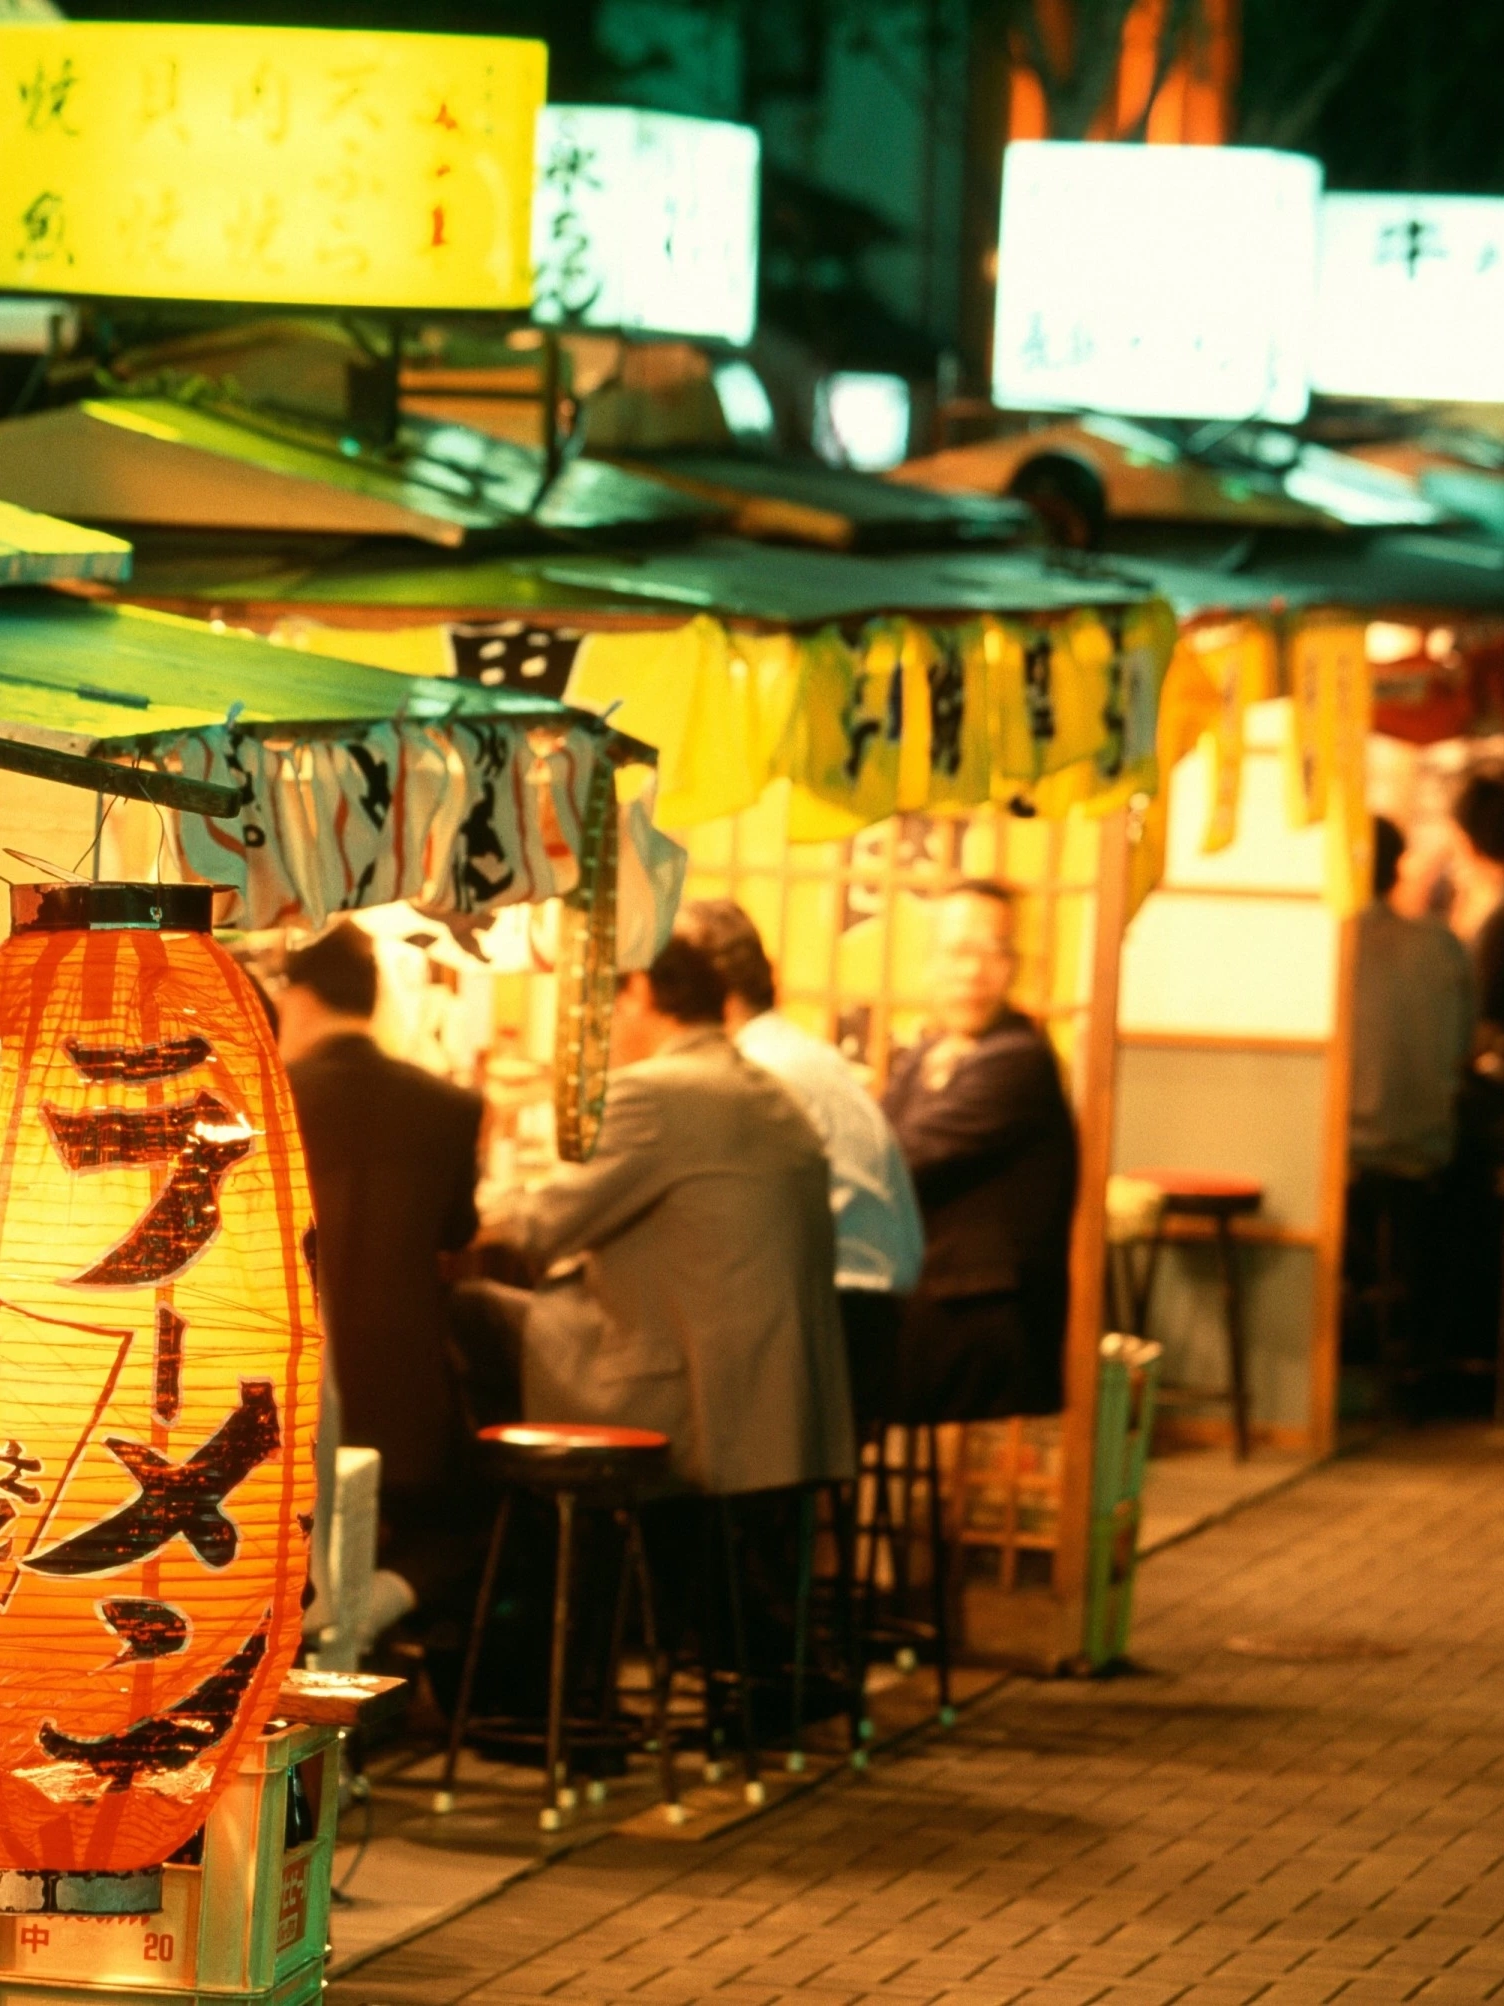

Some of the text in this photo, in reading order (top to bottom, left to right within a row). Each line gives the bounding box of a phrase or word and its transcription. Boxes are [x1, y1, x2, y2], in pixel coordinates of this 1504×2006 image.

[20, 1033, 282, 1794] ラーメン
[20, 1923, 50, 1954] 中
[143, 1932, 174, 1963] 20
